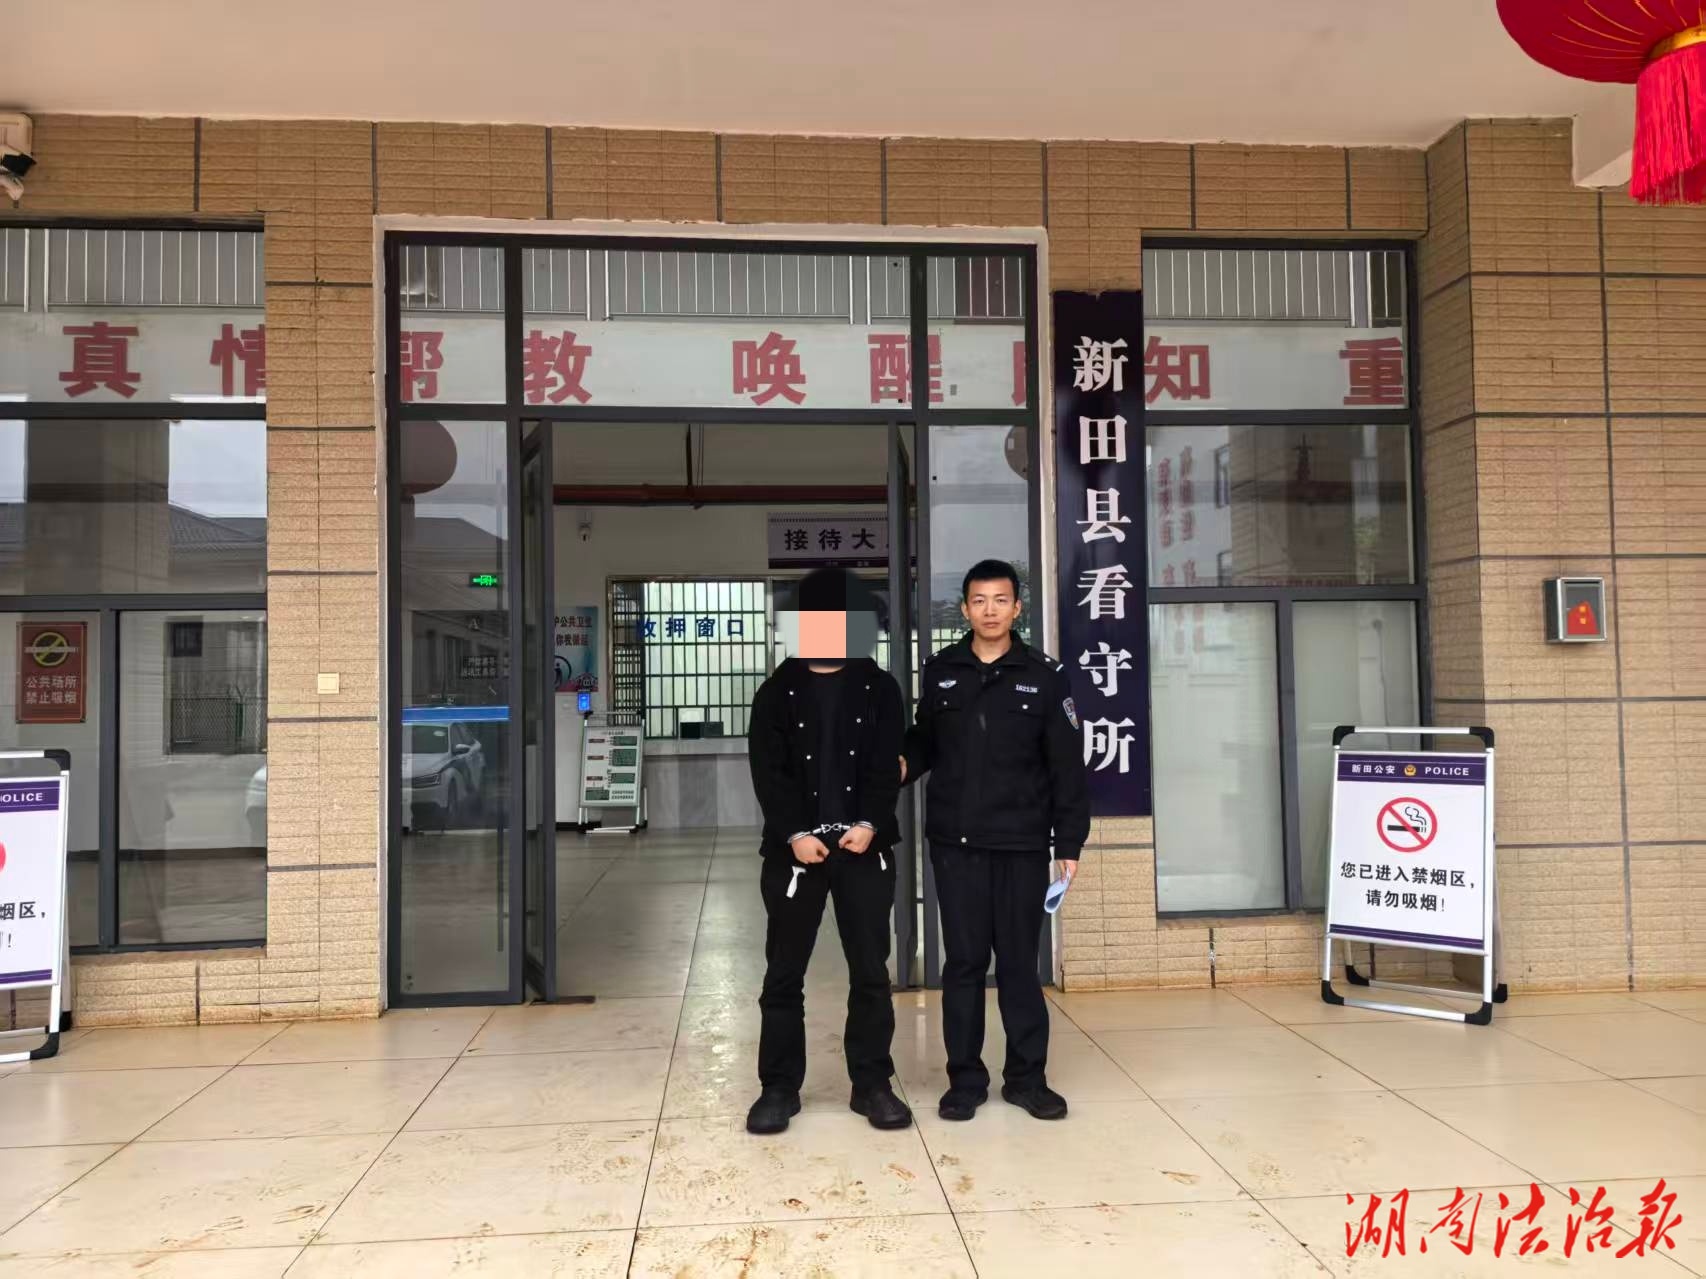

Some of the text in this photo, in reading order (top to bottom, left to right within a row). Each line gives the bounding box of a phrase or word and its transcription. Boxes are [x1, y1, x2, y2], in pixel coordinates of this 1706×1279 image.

[1338, 337, 1405, 405] 重
[785, 528, 889, 551] 接待大
[1073, 336, 1135, 774] 新田县看守所
[637, 616, 743, 638] 收押窗口
[26, 675, 78, 689] 公共场所
[26, 692, 77, 704] 禁止吸烟
[1352, 764, 1470, 776] 新田公安 POLICE
